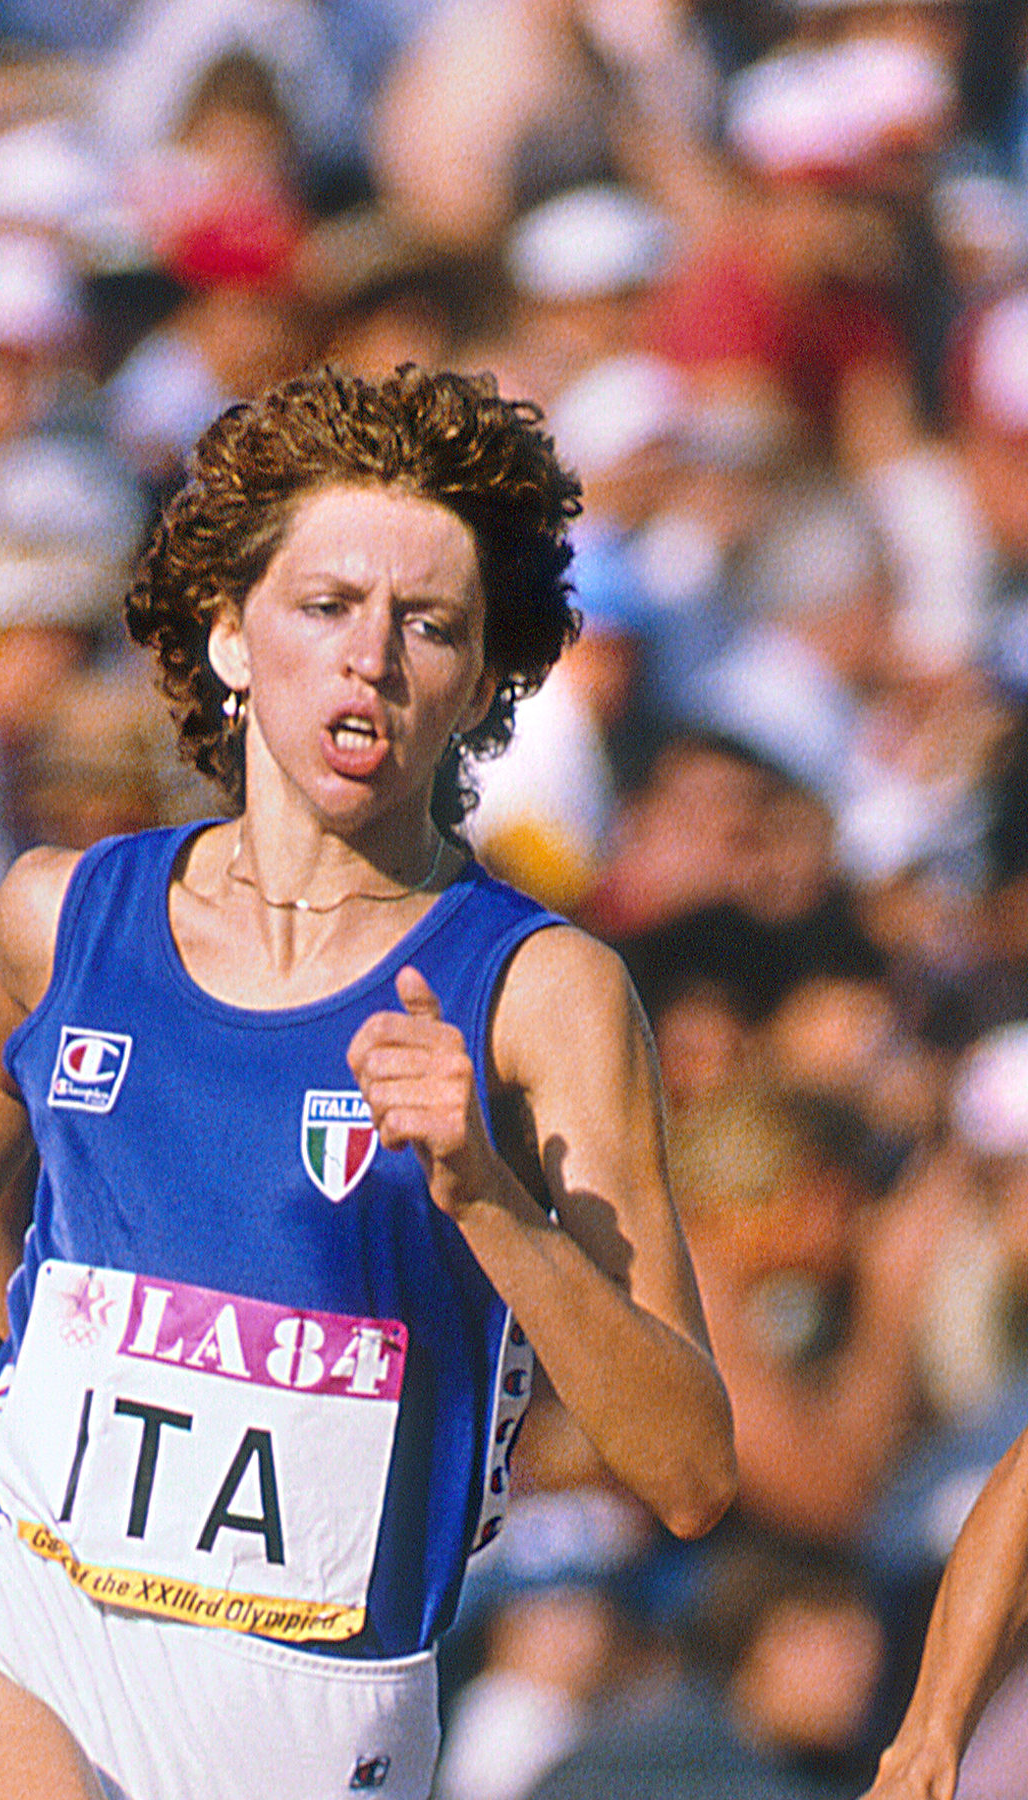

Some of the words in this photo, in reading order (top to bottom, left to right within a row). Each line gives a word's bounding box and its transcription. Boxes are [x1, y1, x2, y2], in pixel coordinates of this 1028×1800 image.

[310, 1098, 371, 1117] ITALIA
[128, 1286, 251, 1377] LA
[266, 1317, 389, 1395] 84
[60, 1389, 285, 1566] ITA
[93, 1573, 130, 1595] the
